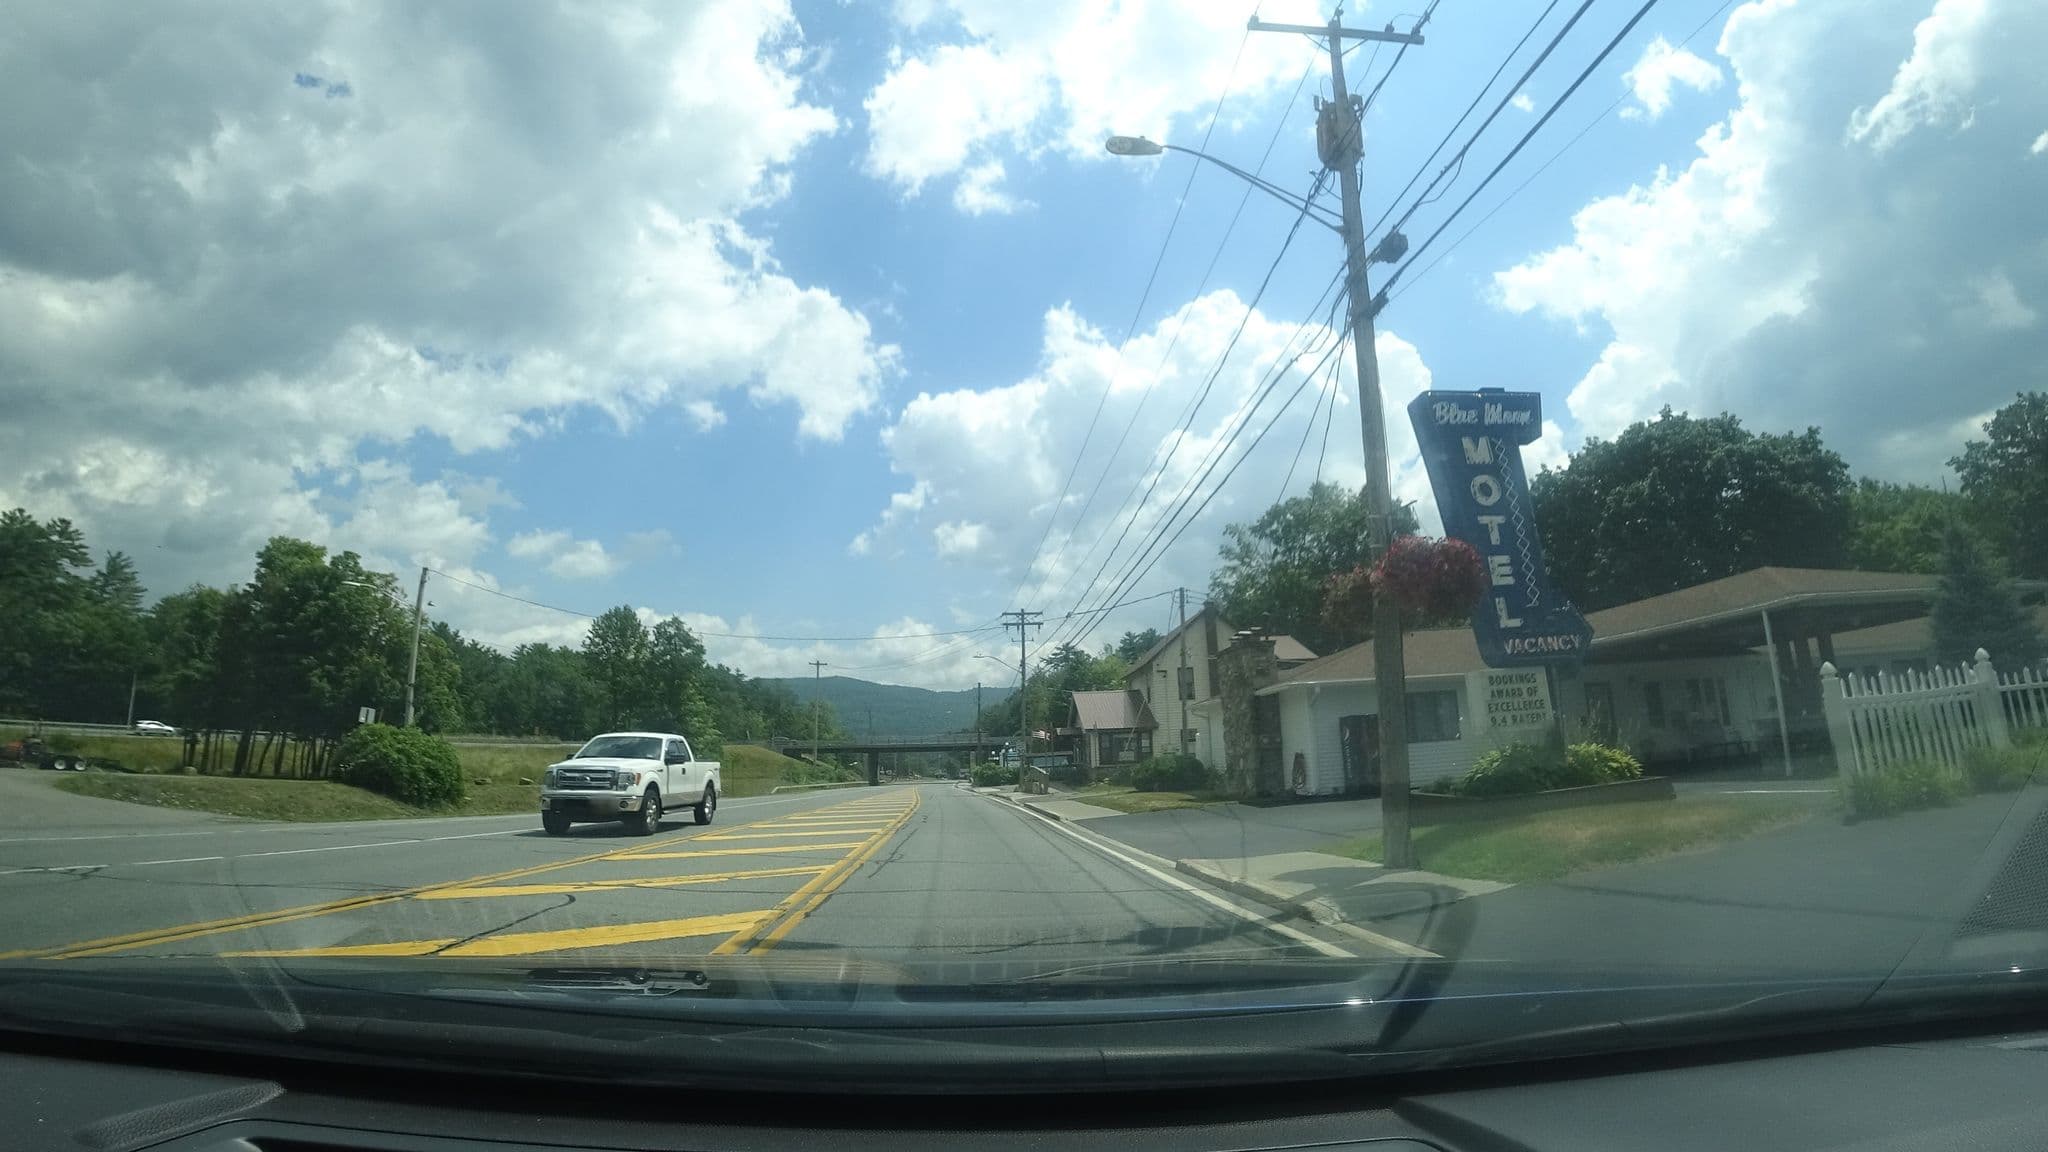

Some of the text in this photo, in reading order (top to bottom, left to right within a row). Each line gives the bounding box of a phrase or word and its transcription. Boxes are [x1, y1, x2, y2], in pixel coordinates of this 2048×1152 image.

[1433, 401, 1479, 425] Blue
[1461, 436, 1523, 628] MOTEL
[1504, 634, 1579, 655] VACANCY
[1488, 673, 1537, 686] BOOKINGS
[1490, 686, 1538, 699] AWARD OF
[1488, 699, 1545, 713] EXCELLENCE
